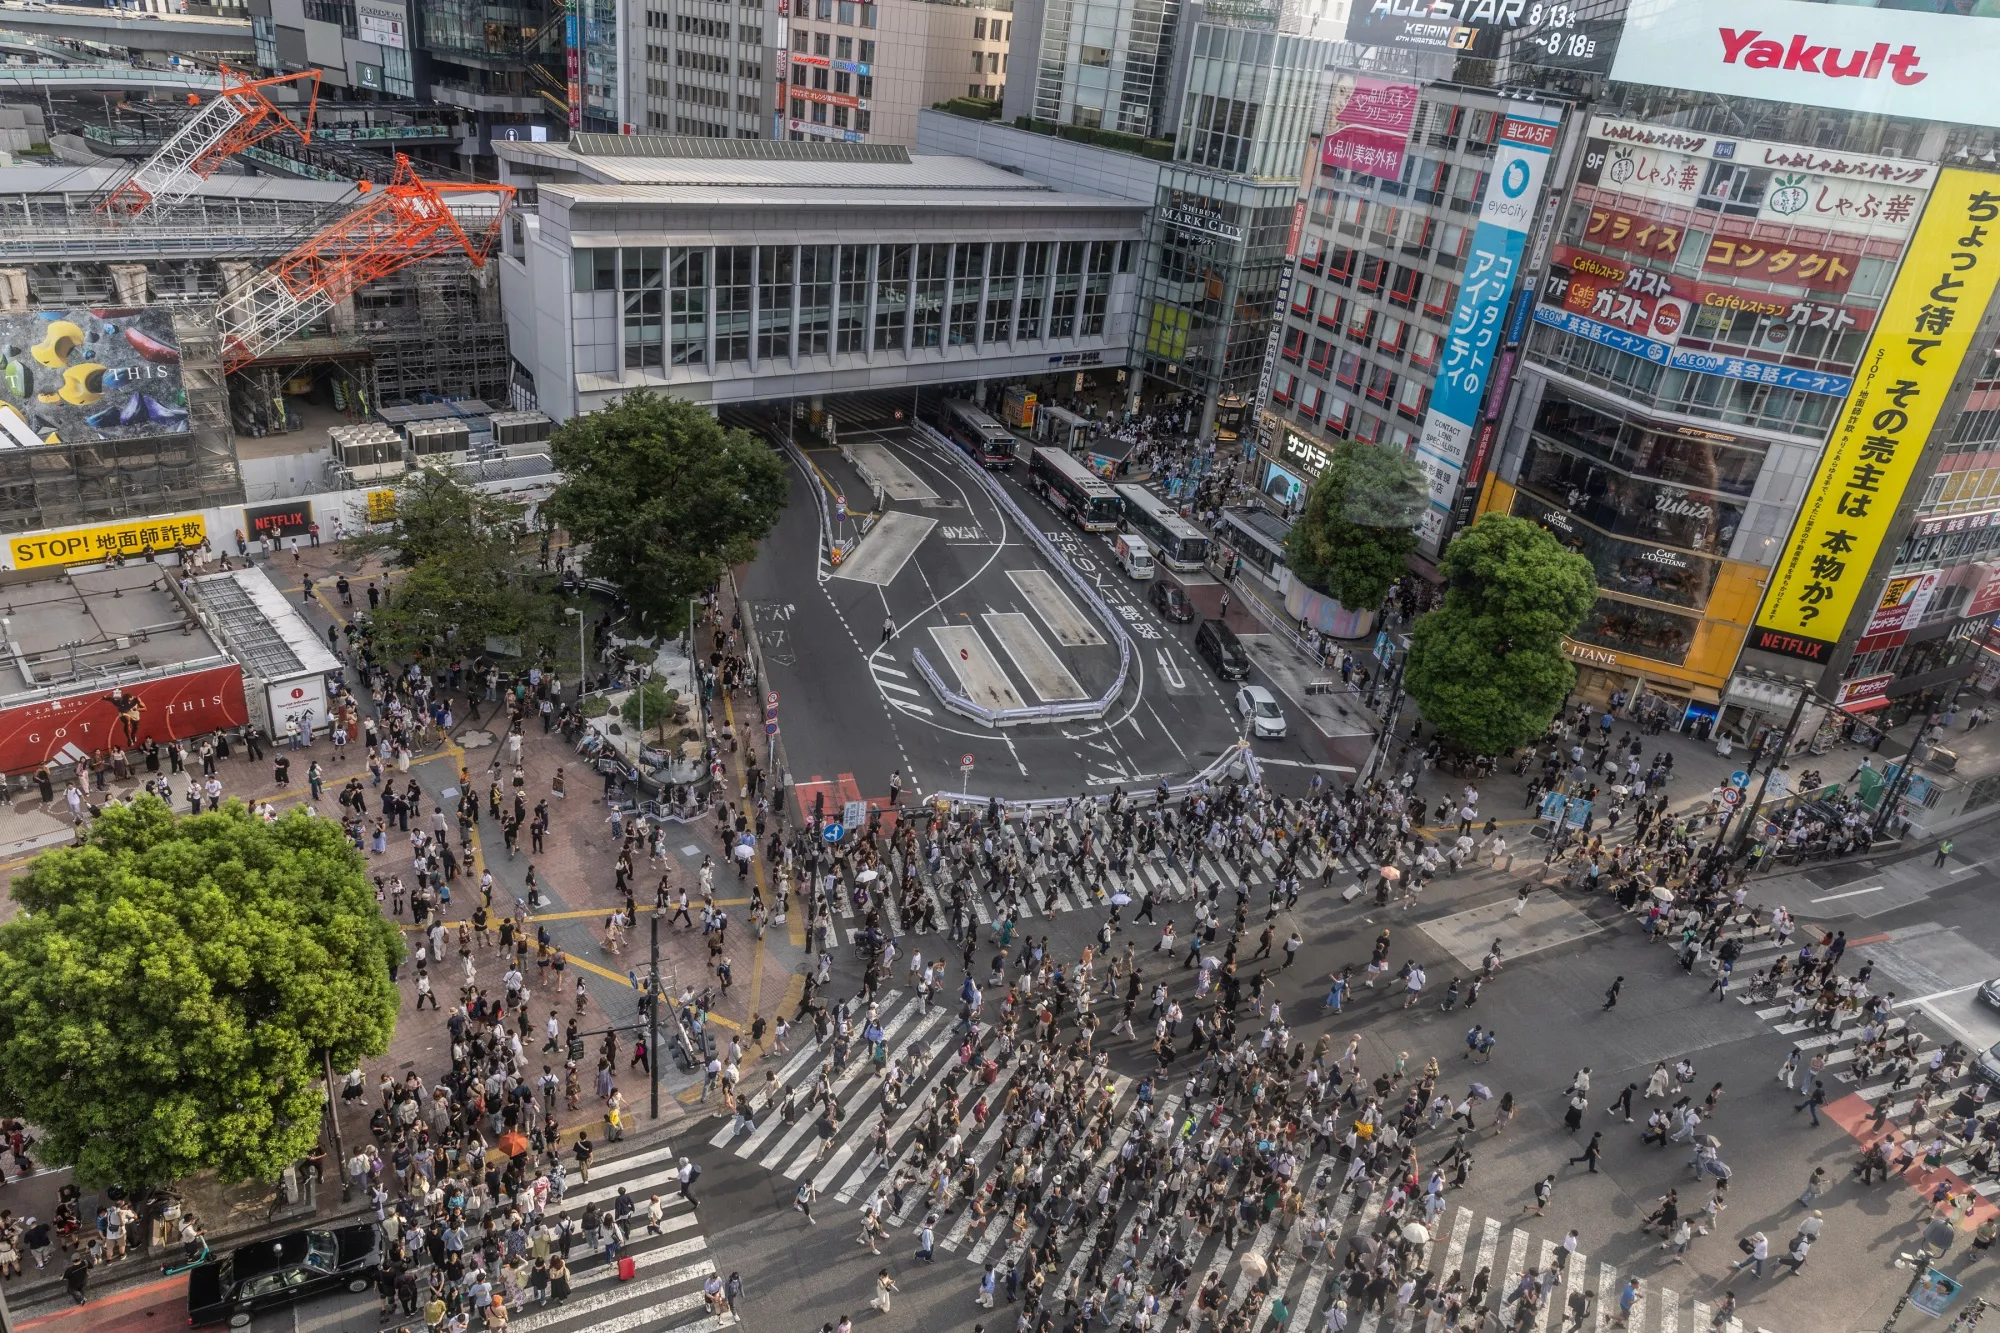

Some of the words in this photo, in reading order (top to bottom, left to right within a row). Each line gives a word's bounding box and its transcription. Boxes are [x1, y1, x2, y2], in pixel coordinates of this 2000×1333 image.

[1530, 4, 1568, 28] 8/13
[1566, 11, 1576, 24] 火
[1405, 22, 1451, 39] KEIRIN
[1410, 37, 1447, 46] HIRATSUKA
[1586, 40, 1596, 53] 日
[1718, 27, 1928, 86] Yakult
[1368, 88, 1412, 108] 品川スキン
[1365, 106, 1404, 125] クリニック
[1507, 122, 1551, 142] 当ビル5F
[1333, 139, 1398, 171] 品川美容外科
[1586, 152, 1605, 169] 9F
[1602, 122, 1707, 152] しゃぶしゃぶバイキング
[1764, 148, 1928, 183] しゃぶしゃぶバイキング
[1636, 157, 1699, 192] しゃぶ葉
[1182, 203, 1221, 219] SHIBUYA
[1488, 201, 1528, 222] eyecity
[1815, 185, 1916, 224] しゃぶ葉
[1161, 207, 1202, 226] MARK
[1208, 220, 1243, 237] CITY
[1589, 212, 1679, 254] プライス
[1709, 240, 1849, 283] コンタクト
[1549, 276, 1569, 296] 7F
[1625, 268, 1672, 297] ガスト
[1907, 190, 2000, 366] ちょっと待て
[1571, 283, 1595, 300] Café
[1447, 250, 1496, 386] アイシティ
[1592, 289, 1648, 326] ガスト
[1786, 302, 1856, 331] ガスト
[1463, 257, 1513, 394] コンタクトの
[1537, 307, 1563, 325] AEON
[1567, 316, 1645, 351] 英会話イーオン
[1658, 315, 1677, 327] ガスト
[1267, 344, 1276, 358] 内科
[110, 365, 168, 381] THIS
[1678, 353, 1718, 370] AEON
[1725, 359, 1848, 392] 英会話イーオン
[1865, 348, 1885, 389] STOP!
[1844, 390, 1869, 433] 地面師詐欺
[1434, 419, 1461, 437] CONTACT
[1438, 430, 1452, 442] LENS
[1425, 433, 1461, 456] SPECIALISTS
[1478, 426, 1491, 457] 外貨両替
[1836, 379, 1921, 518] その売主は
[1287, 434, 1333, 474] サンドラッ
[1303, 463, 1321, 478] CARER
[255, 512, 303, 530] NETFLIX
[17, 536, 90, 562] STOP!
[96, 522, 202, 550] 地面師詐欺
[1898, 536, 1943, 561] AGA
[1641, 551, 1686, 568] L'OCCITANE
[1656, 549, 1676, 560] CAFÉ
[1798, 529, 1857, 628] 本物か?
[1982, 581, 2000, 598] アコ
[1883, 582, 1904, 607] 薬
[1947, 617, 1989, 642] LUSH
[1560, 641, 1617, 665] CITANE
[1760, 632, 1823, 659] NETFLIX
[166, 695, 221, 715] THIS
[277, 701, 293, 709] Tourist
[294, 696, 320, 706] Information
[29, 722, 91, 744] GOT
